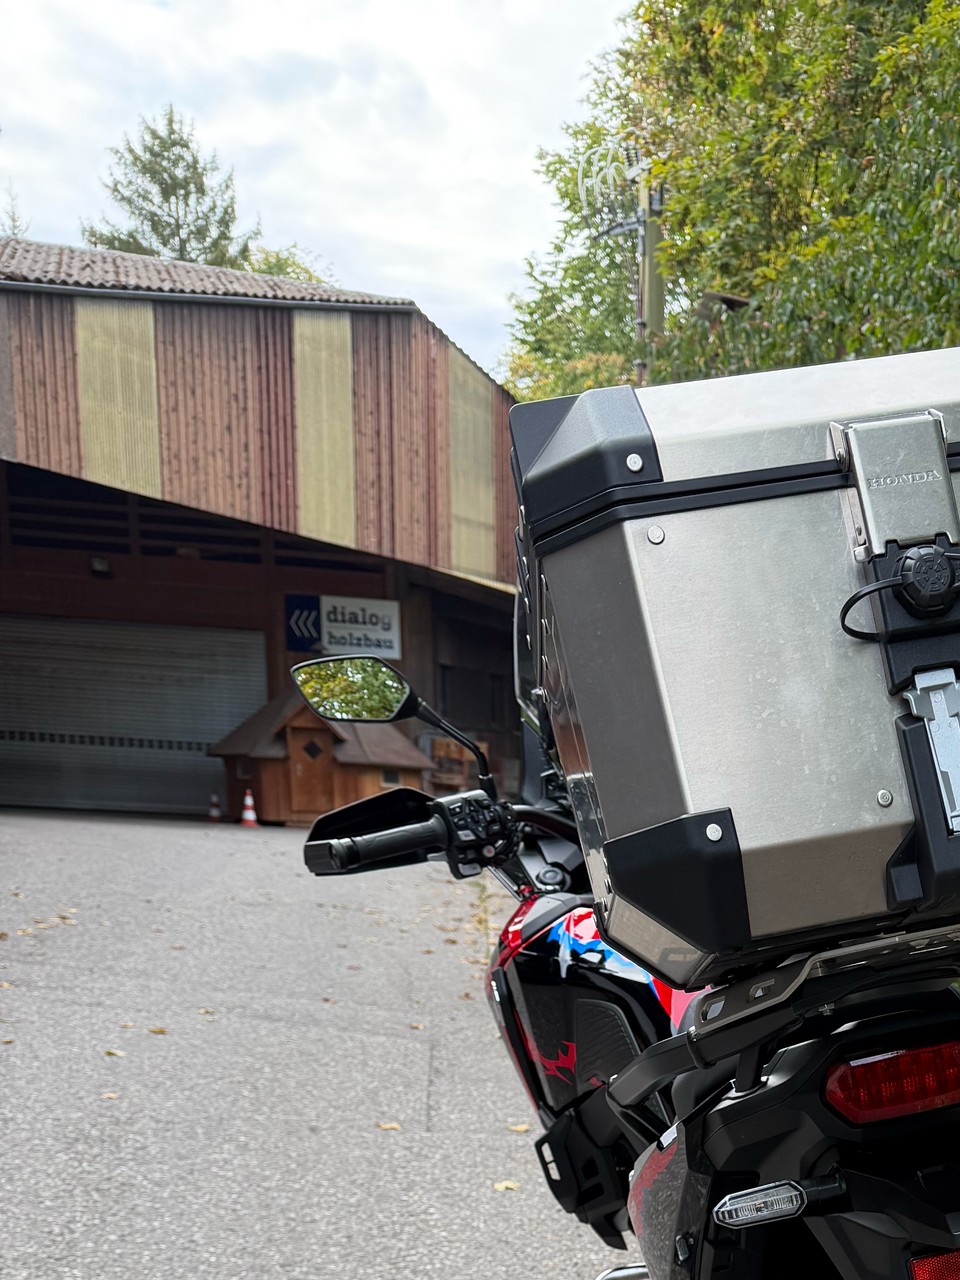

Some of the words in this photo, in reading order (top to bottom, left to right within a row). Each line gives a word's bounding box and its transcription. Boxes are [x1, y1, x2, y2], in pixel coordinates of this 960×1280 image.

[867, 470, 942, 489] HONDA
[327, 605, 392, 631] dialog
[327, 631, 394, 649] holzbau
